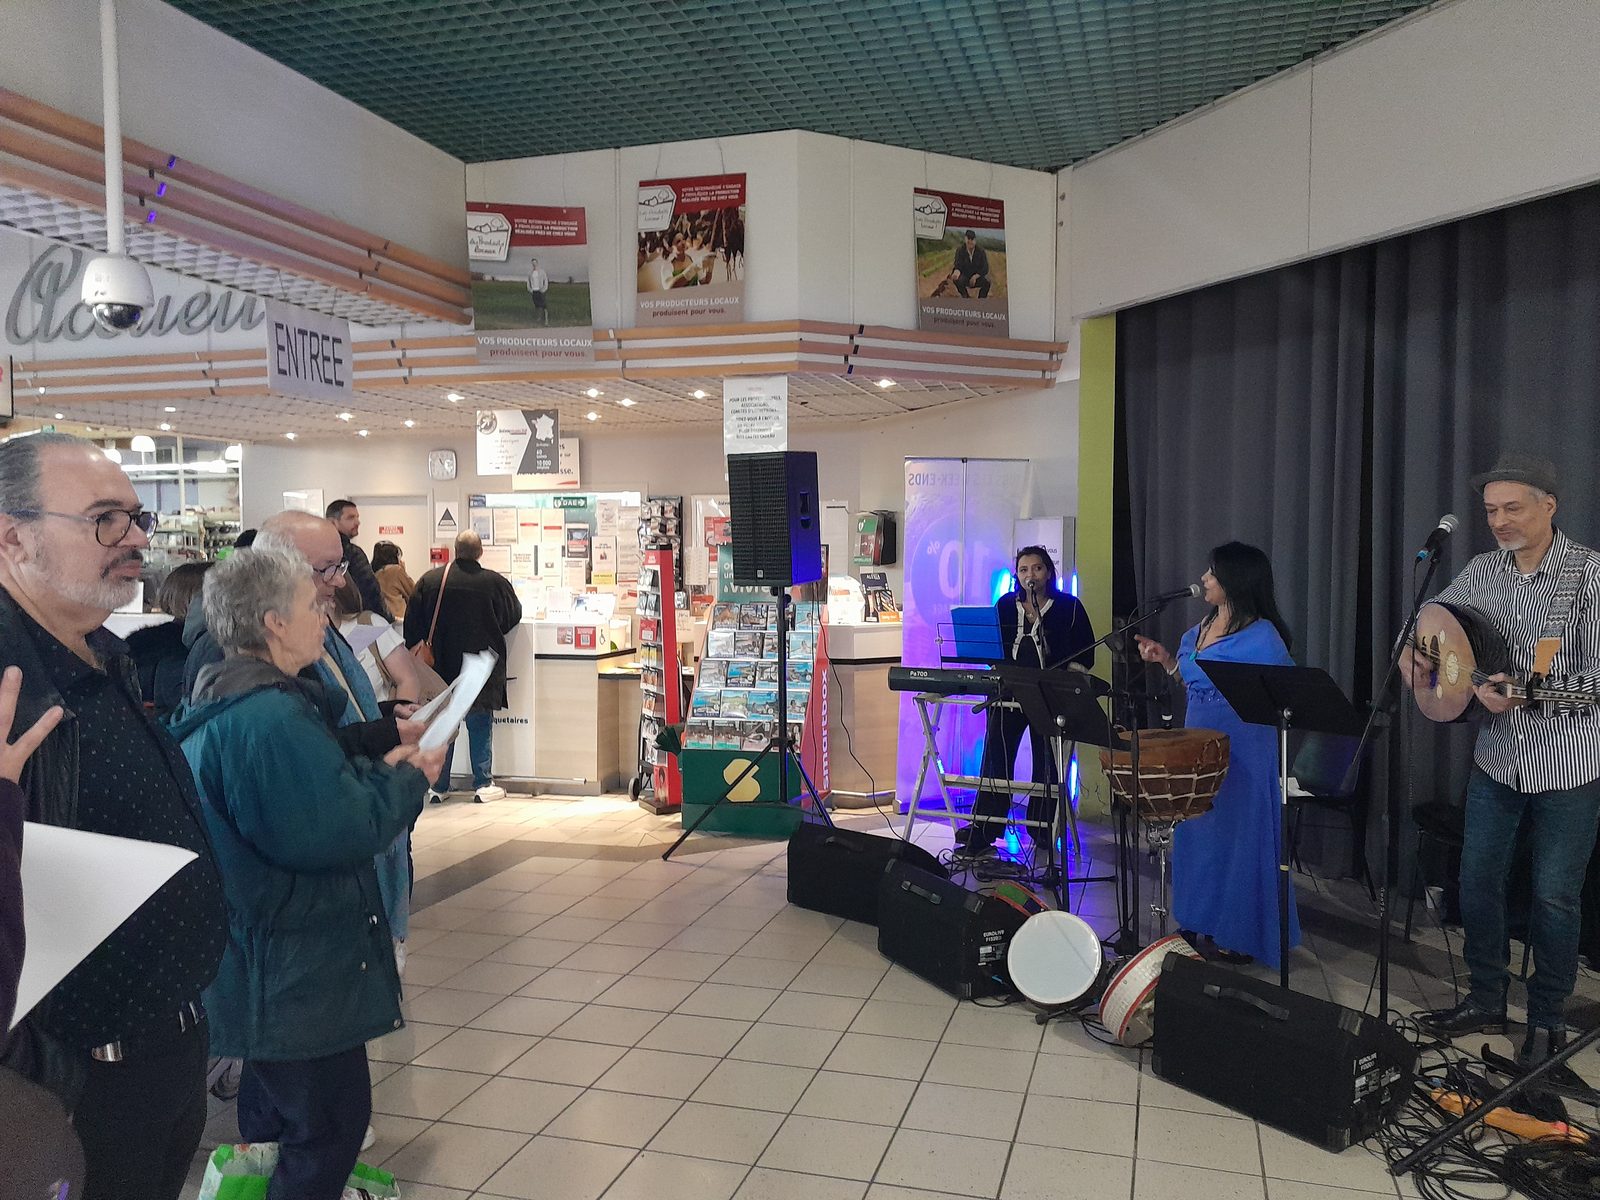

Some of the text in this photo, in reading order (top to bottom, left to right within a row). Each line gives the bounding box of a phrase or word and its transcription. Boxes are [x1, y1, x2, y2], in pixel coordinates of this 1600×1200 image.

[640, 297, 739, 308] VOS PRODUCTEURS LOCAUX
[653, 308, 688, 318] produisent
[691, 308, 706, 316] pour
[922, 305, 1007, 321] VOS PRODUCTEURS LOCAUX
[478, 336, 592, 347] VOS PRODUCTEURS LOCAUX
[275, 323, 345, 388] ENTREE
[489, 348, 538, 357] produisent
[541, 349, 562, 358] pour
[492, 716, 529, 725] quetaires
